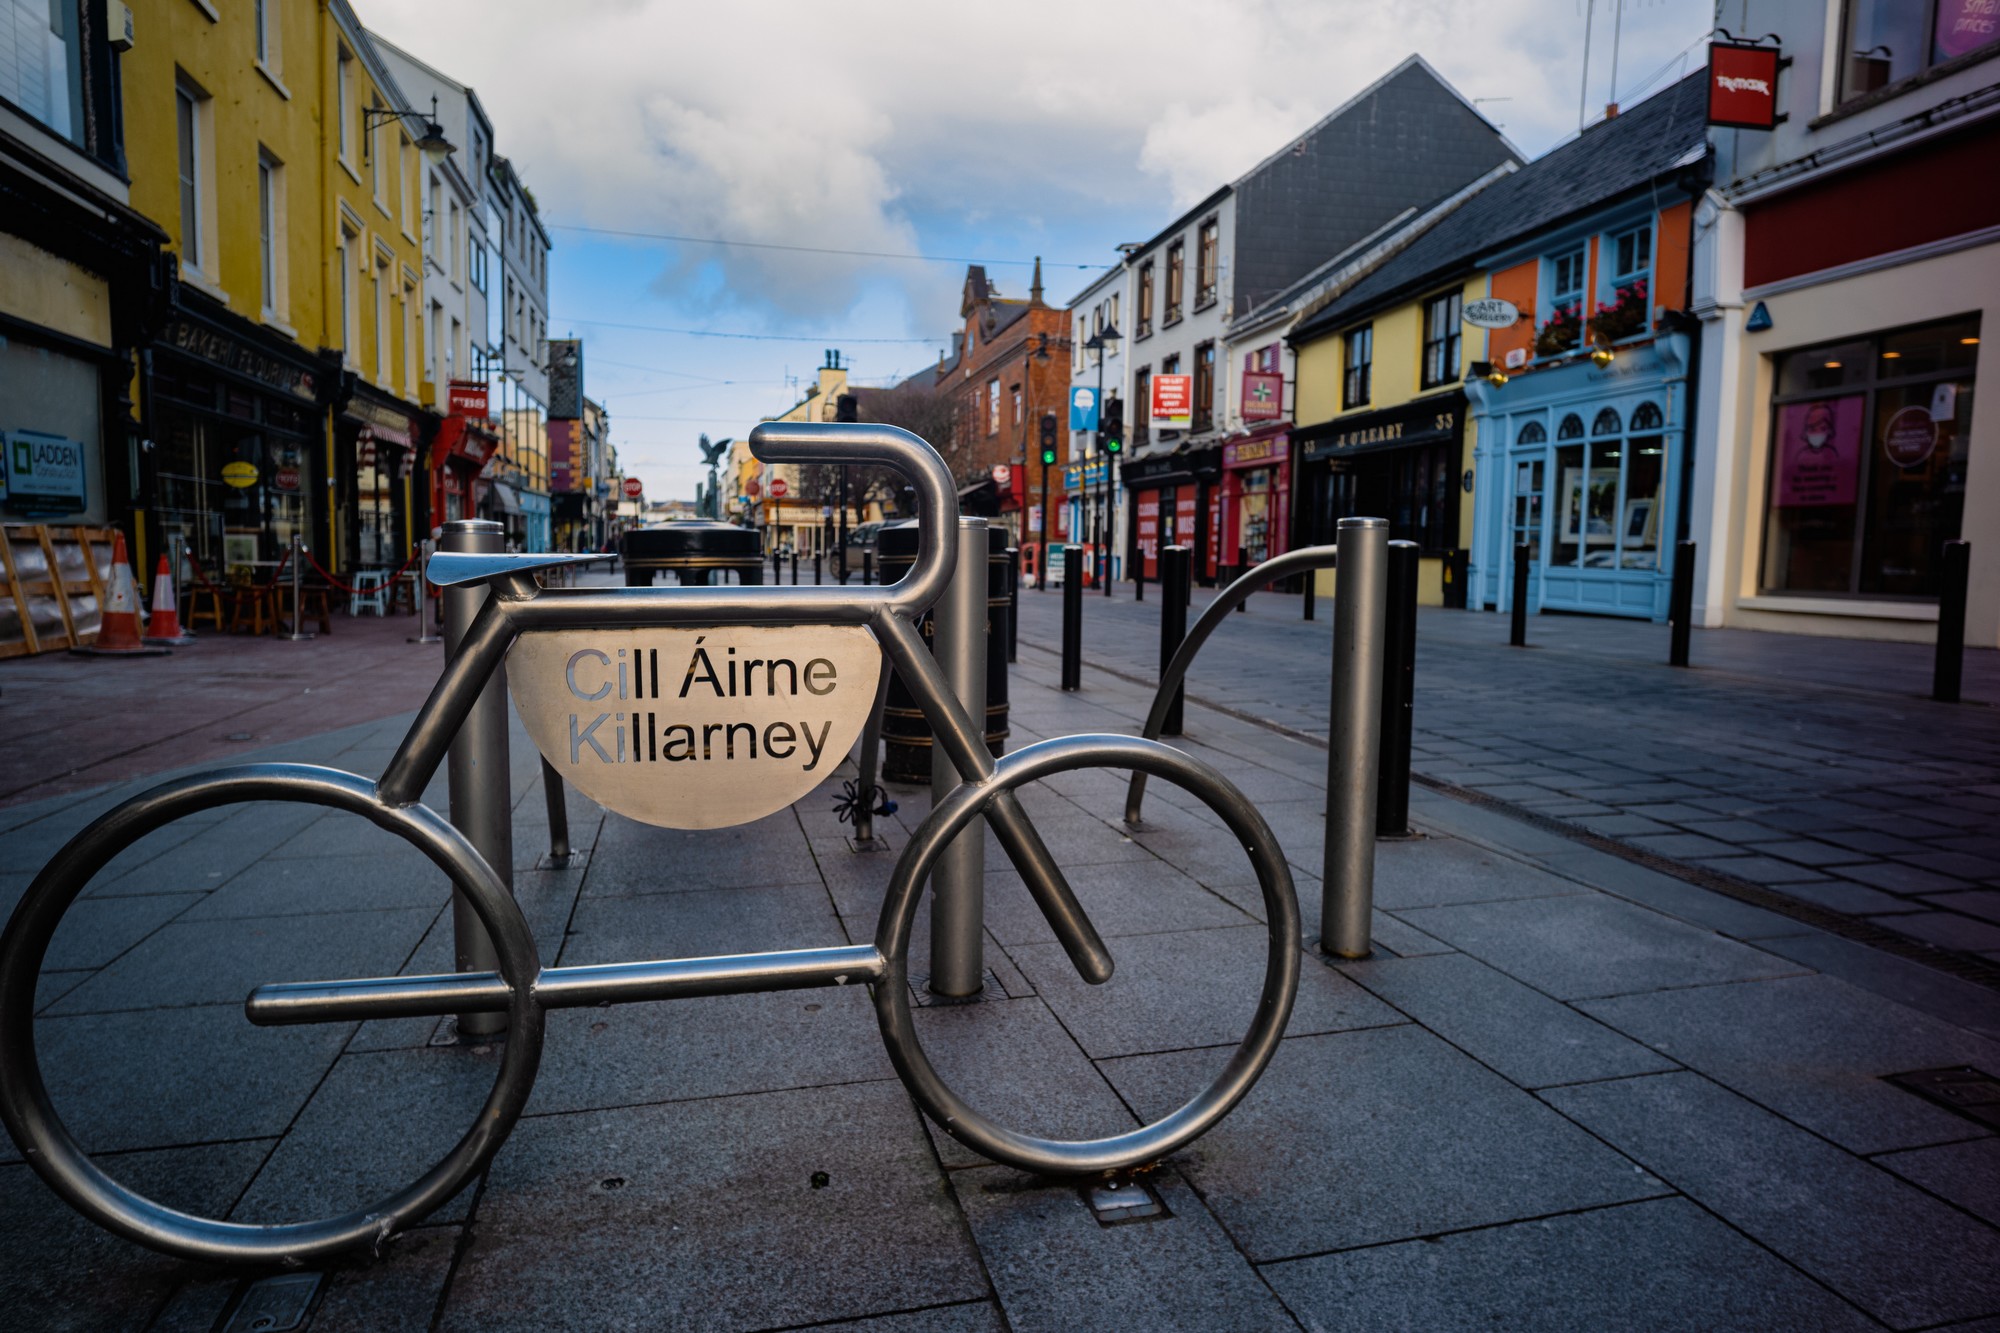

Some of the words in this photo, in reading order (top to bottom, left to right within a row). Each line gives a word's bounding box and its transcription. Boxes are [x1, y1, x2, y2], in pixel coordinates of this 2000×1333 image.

[1435, 413, 1454, 430] 33
[624, 482, 641, 492] STOP
[771, 483, 786, 493] STOP
[566, 648, 658, 701] Cill
[679, 635, 837, 699] Áirne
[568, 712, 832, 771] Killarney
